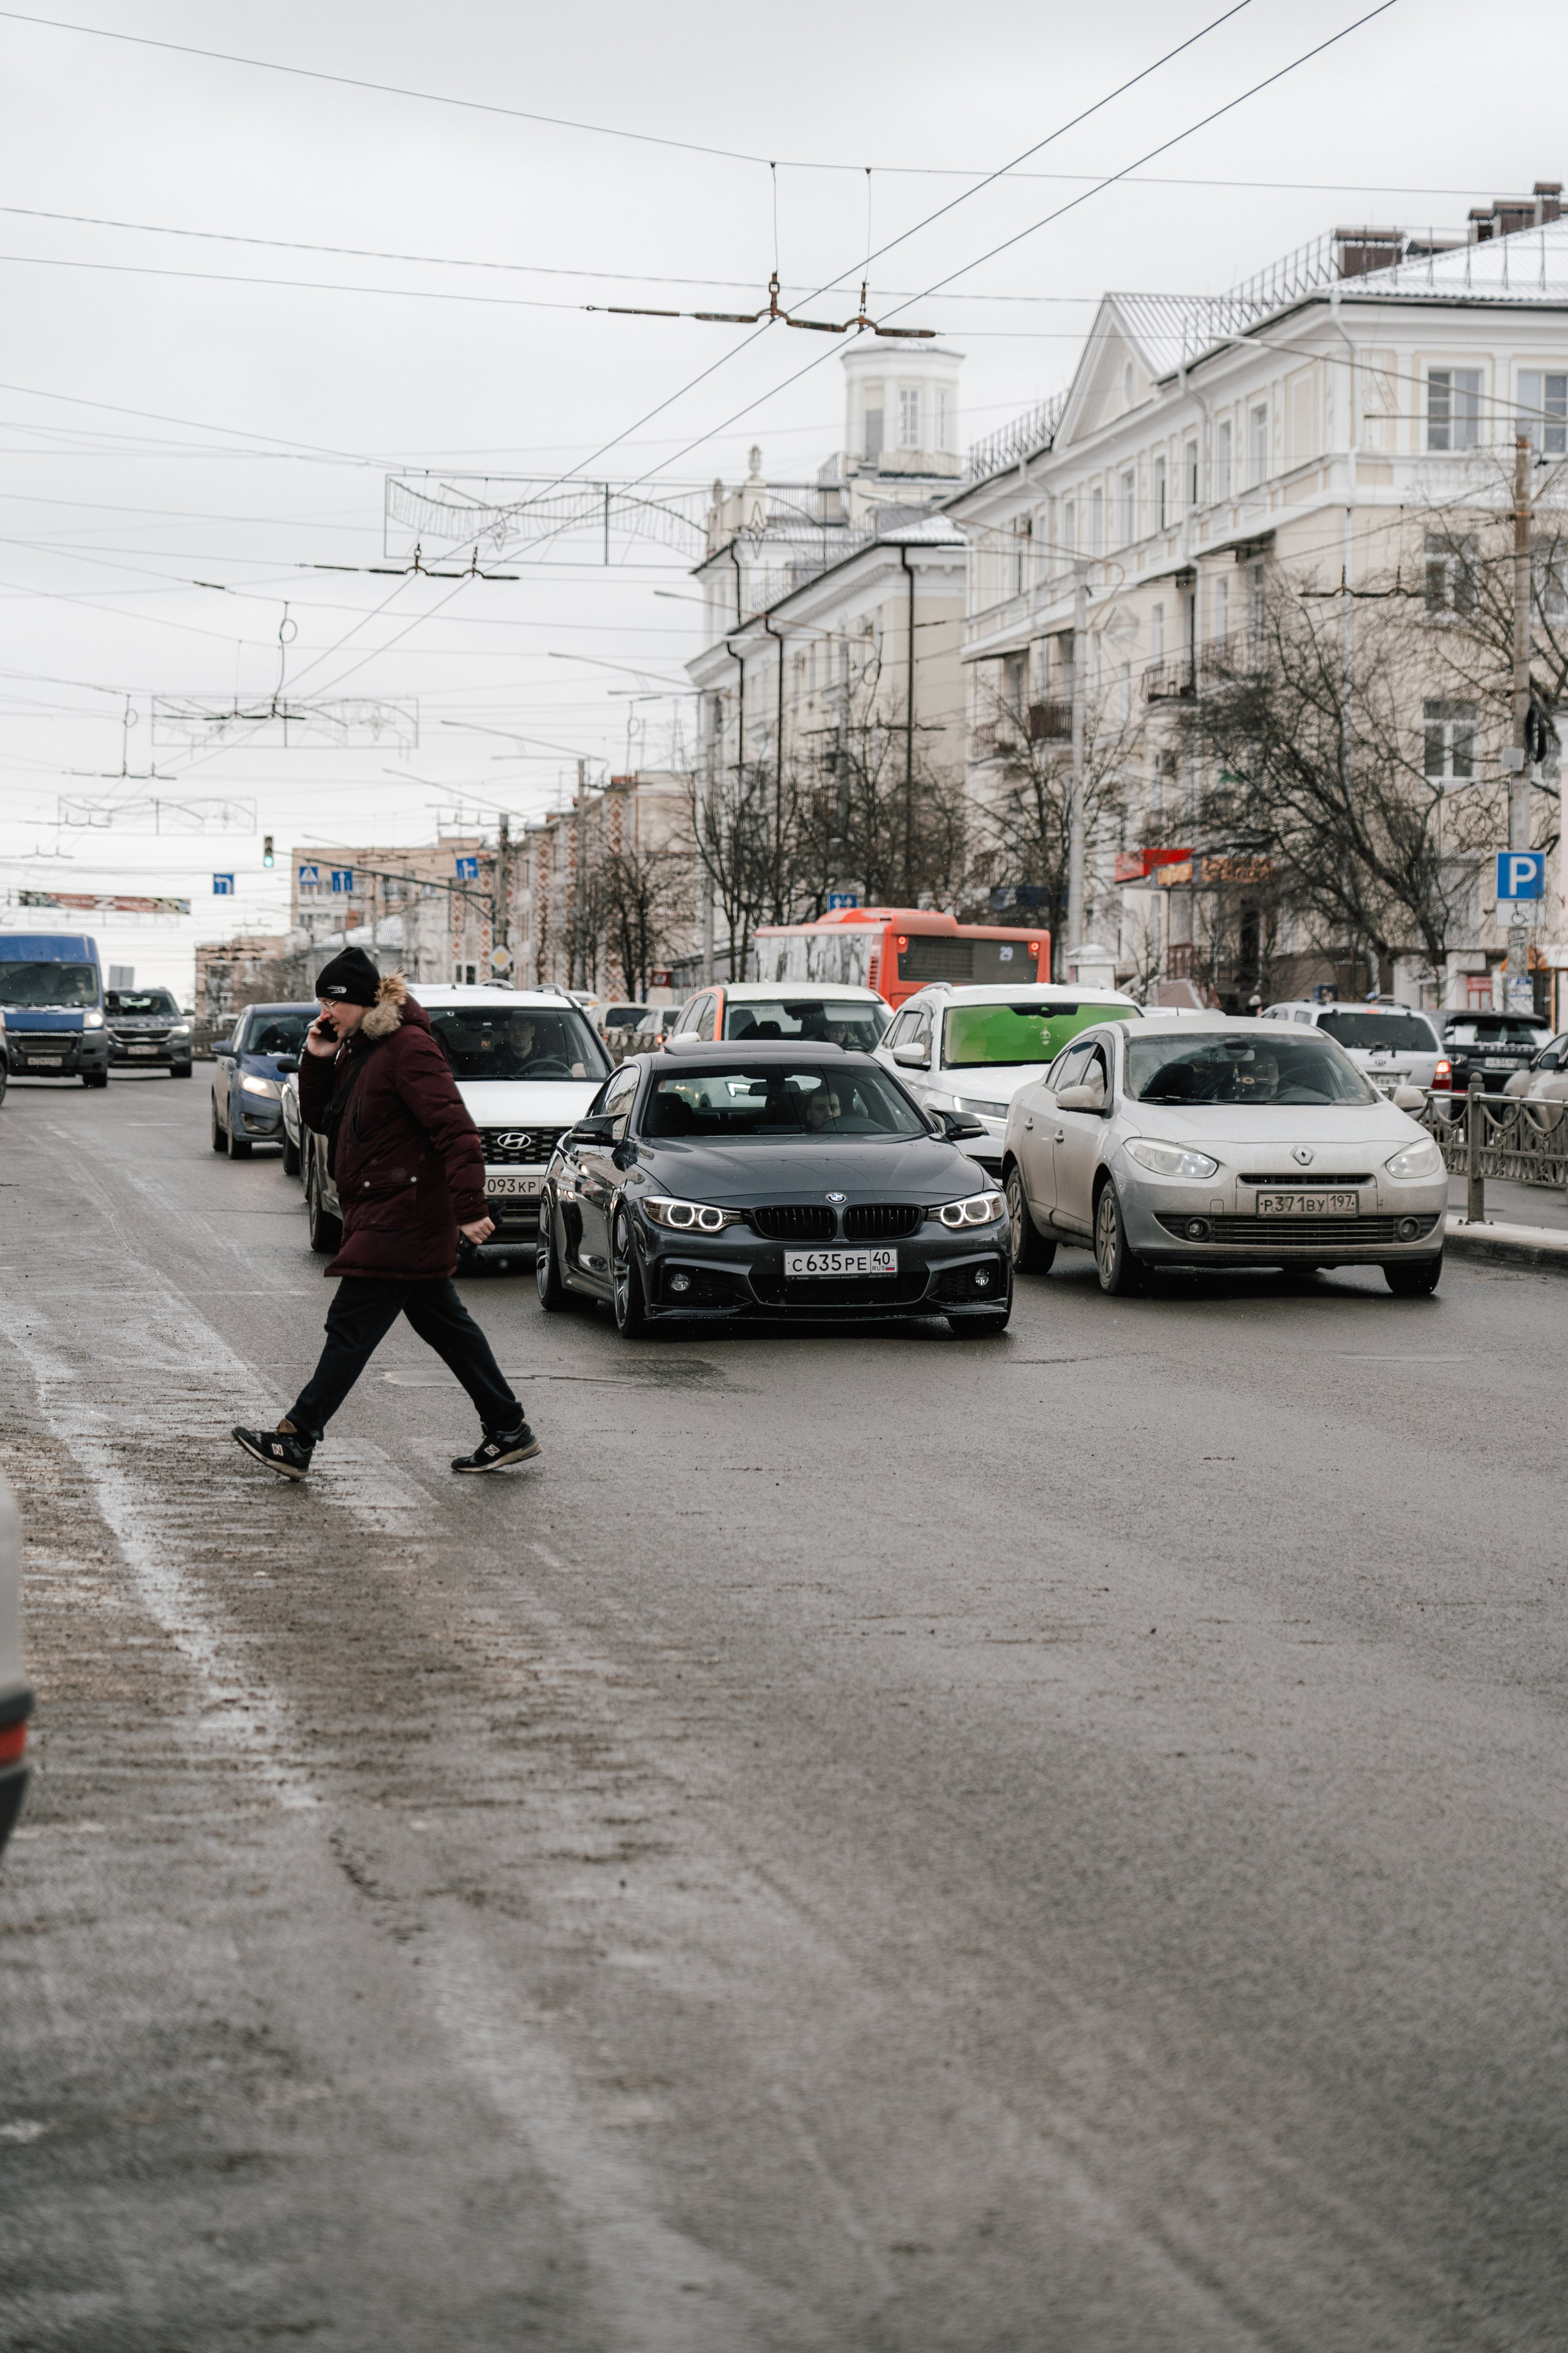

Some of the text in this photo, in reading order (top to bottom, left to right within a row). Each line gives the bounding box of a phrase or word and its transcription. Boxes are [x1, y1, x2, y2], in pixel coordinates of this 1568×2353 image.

[1509, 856, 1537, 896] P
[94, 896, 116, 911] Z
[487, 1178, 537, 1193] 093КР
[1264, 1195, 1352, 1212] Р371ВУ 197
[792, 1252, 891, 1272] С635РЕ 40
[271, 1443, 284, 1456] N
[484, 1444, 500, 1457] N
